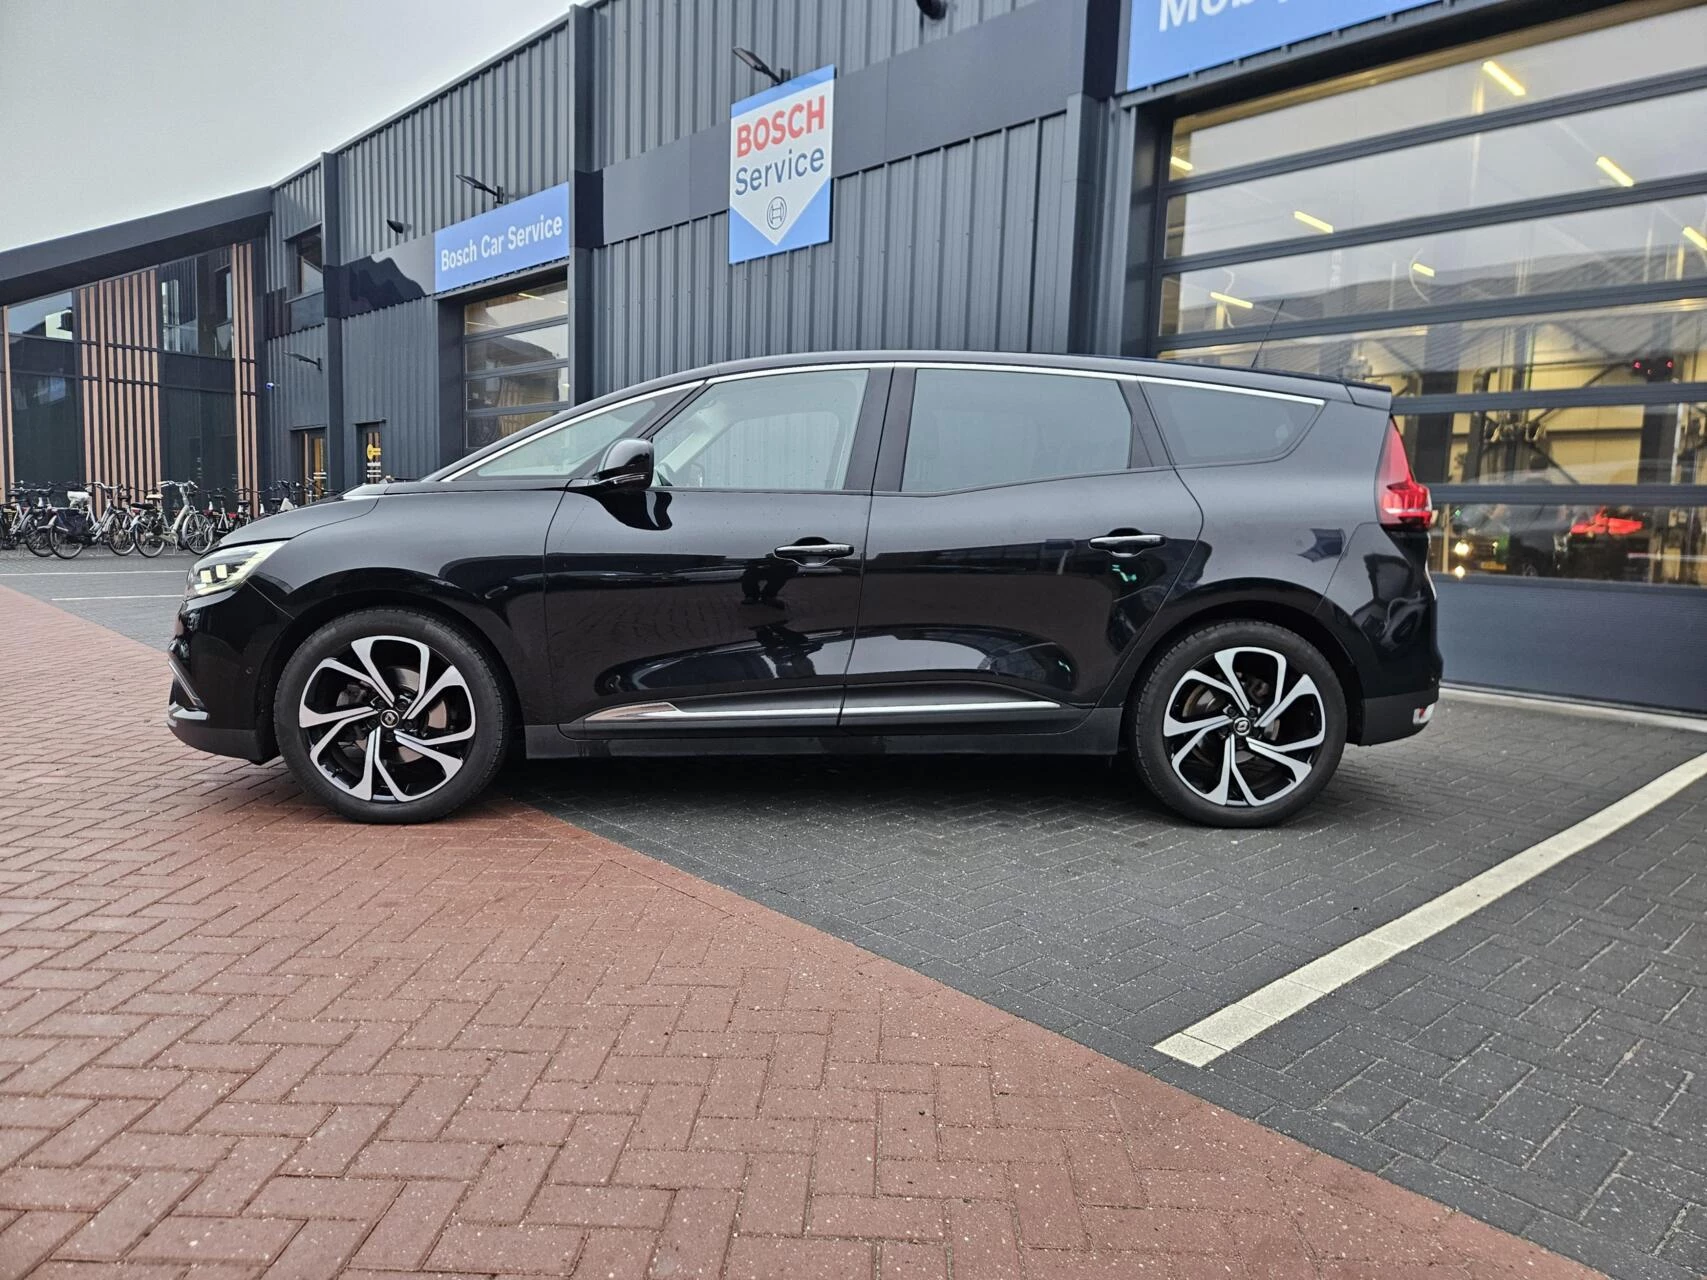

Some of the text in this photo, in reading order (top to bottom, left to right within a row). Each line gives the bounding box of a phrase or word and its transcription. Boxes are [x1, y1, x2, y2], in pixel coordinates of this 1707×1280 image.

[737, 96, 825, 158] BOSCH
[735, 148, 824, 196] Service
[441, 215, 562, 272] Bosch Car Service
